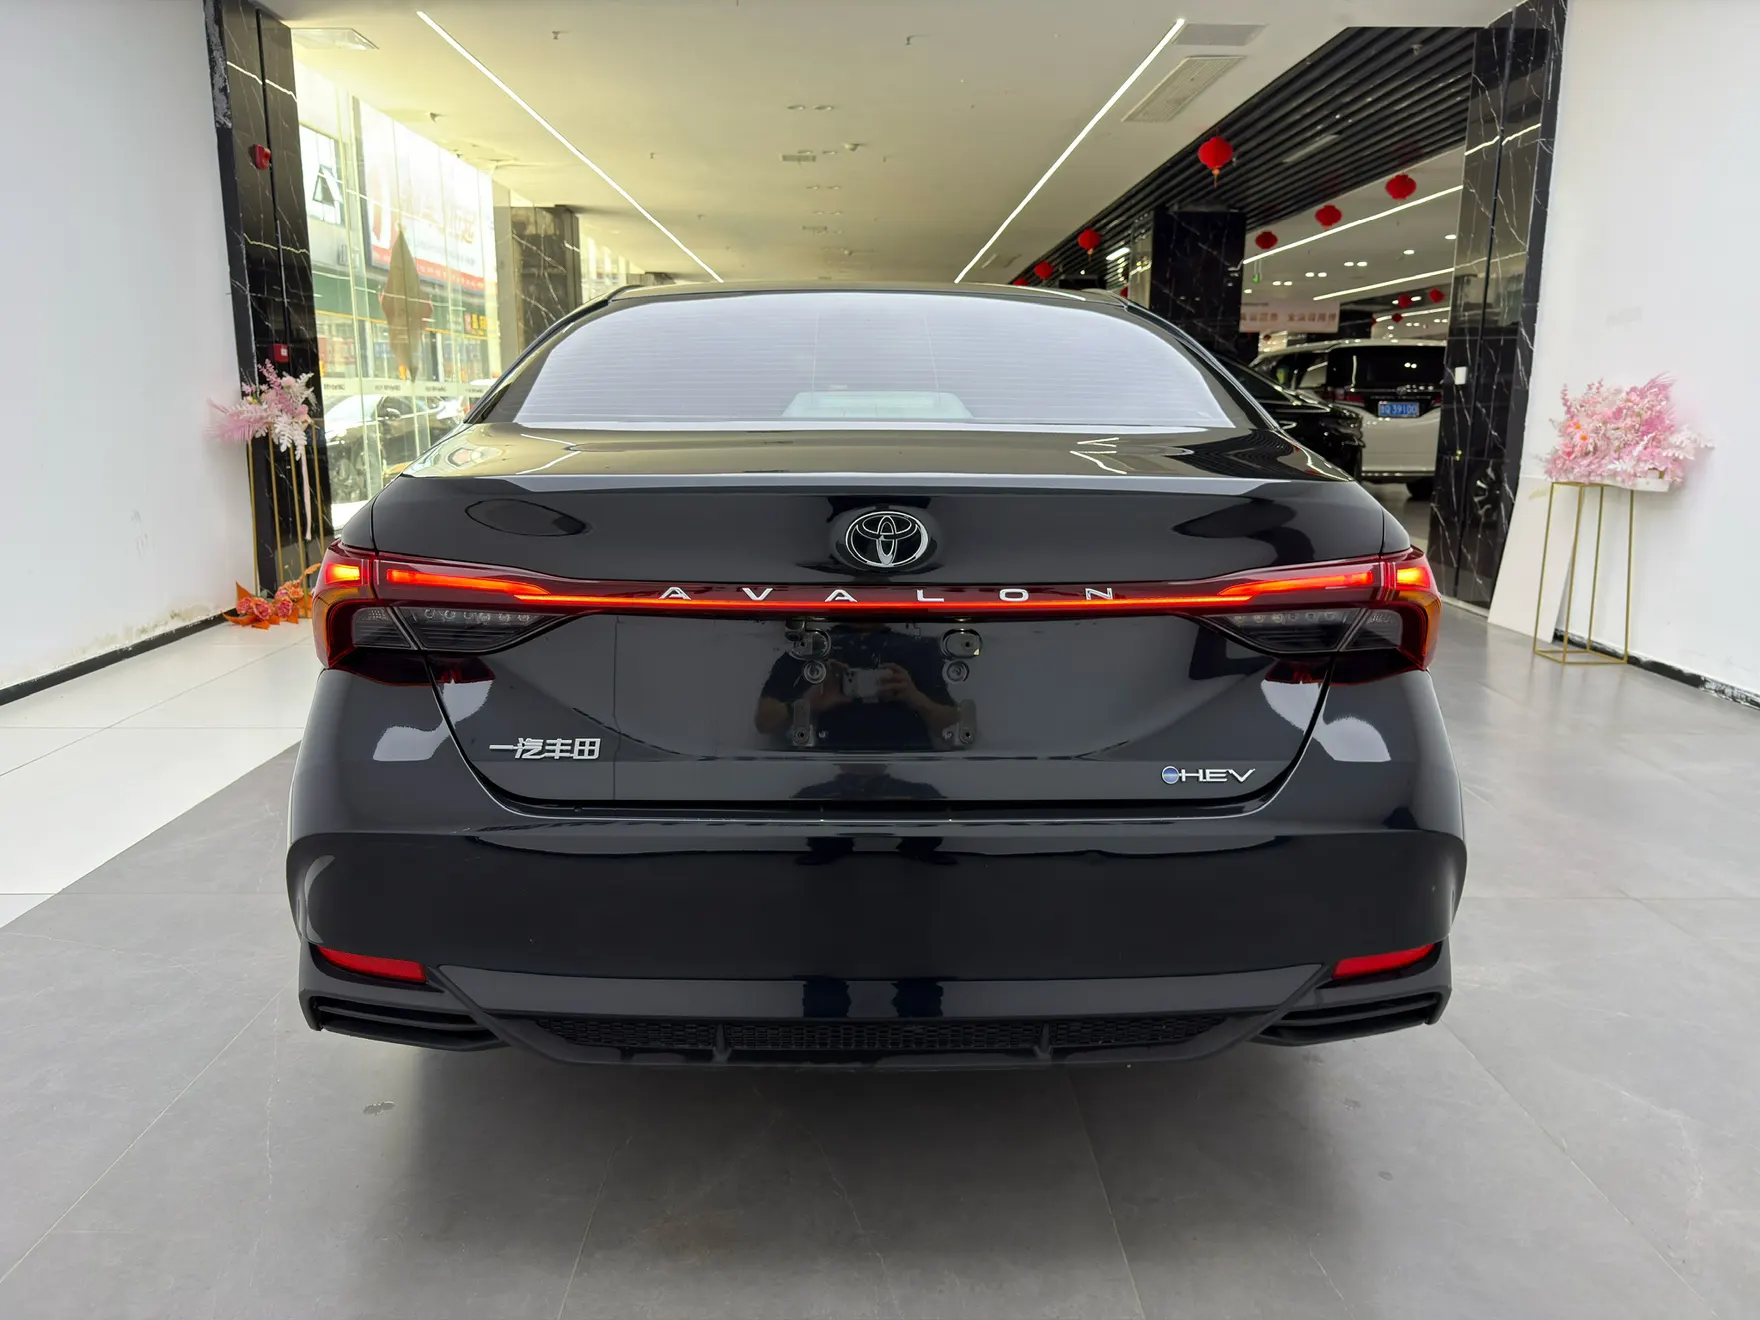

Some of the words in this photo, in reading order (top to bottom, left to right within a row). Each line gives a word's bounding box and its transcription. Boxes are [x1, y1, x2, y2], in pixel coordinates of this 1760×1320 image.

[658, 586, 1114, 603] AVALON
[489, 738, 601, 759] 一汽丰田
[1180, 768, 1256, 783] HEV
